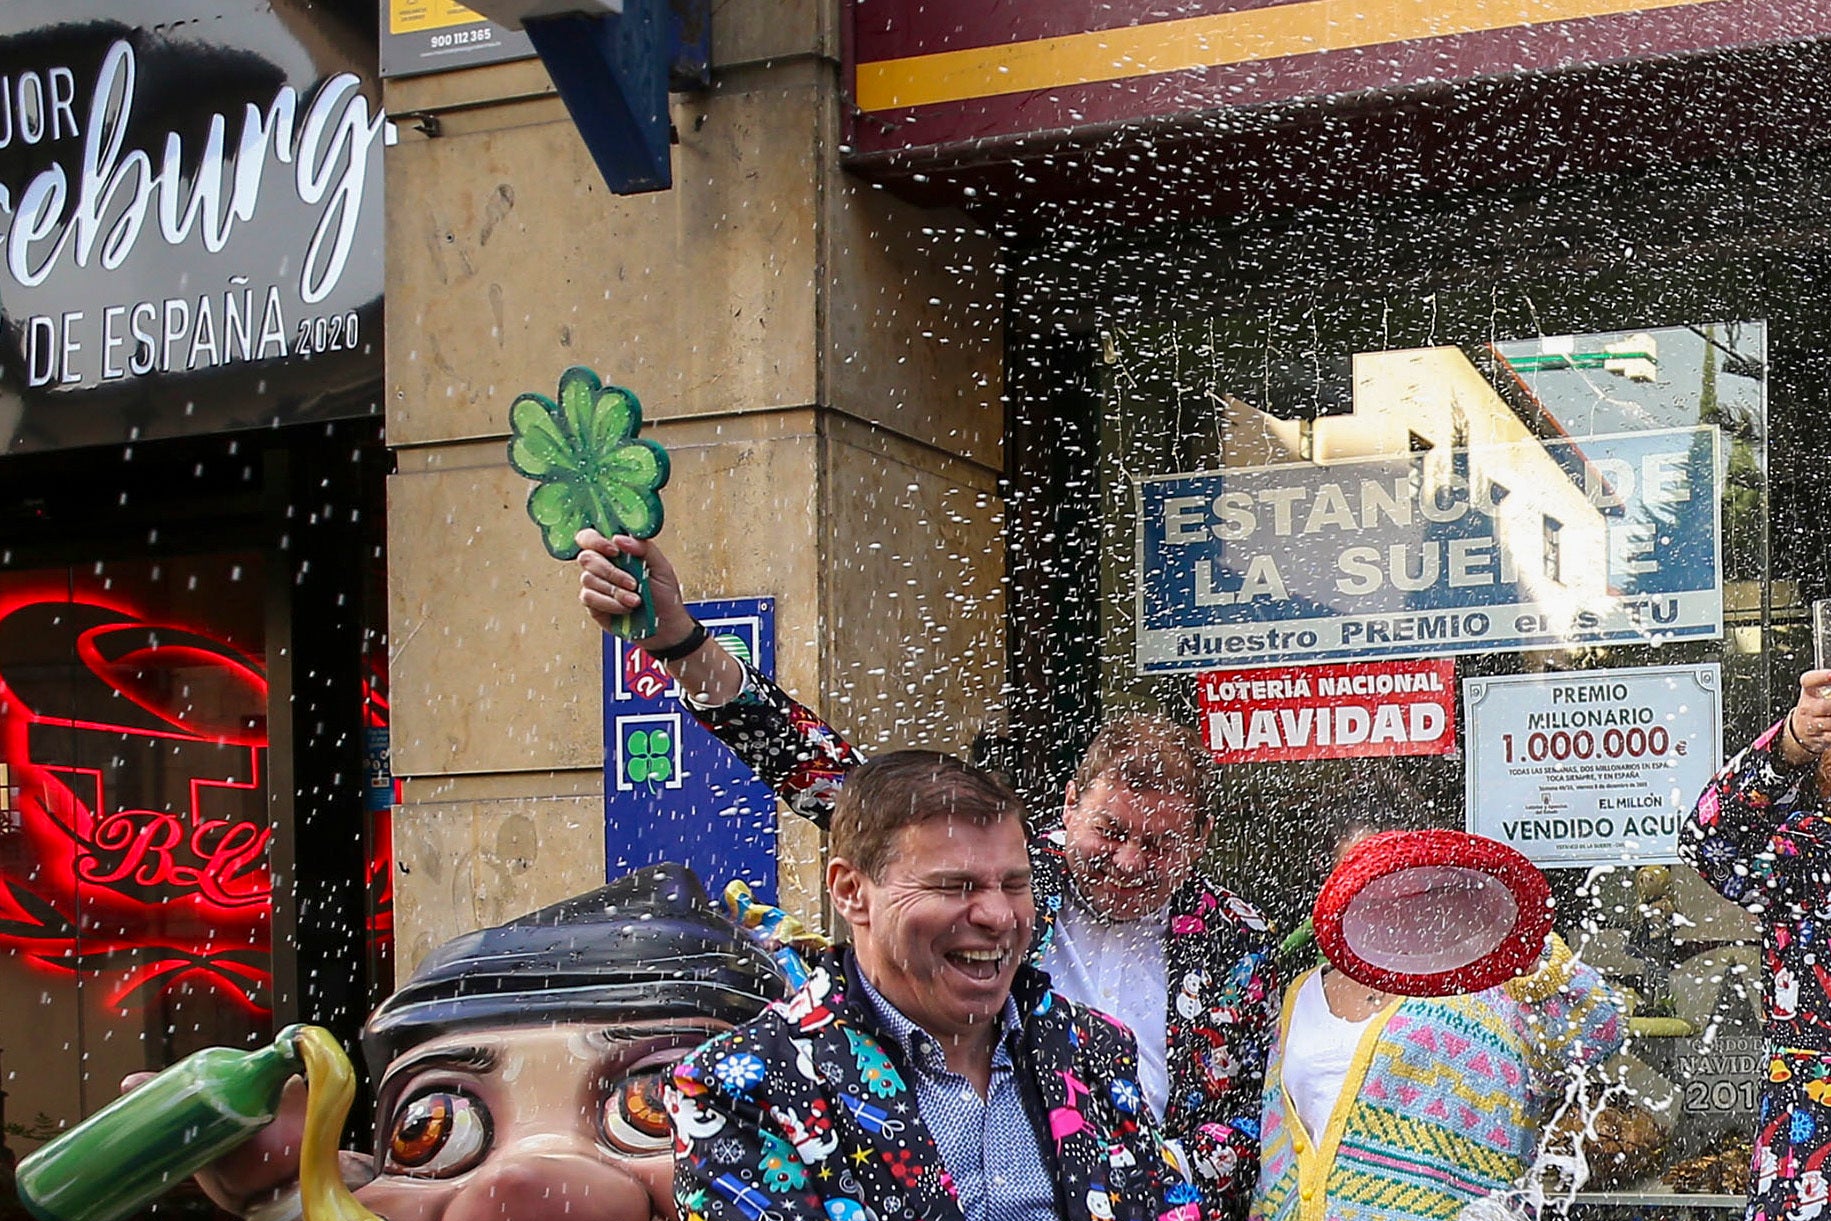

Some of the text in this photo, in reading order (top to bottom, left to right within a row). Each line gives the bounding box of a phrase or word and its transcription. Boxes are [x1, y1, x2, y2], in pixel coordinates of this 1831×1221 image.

[430, 28, 492, 48] 900 112 365
[0, 39, 388, 304] eburg
[29, 275, 359, 387] DE ESPAÑA 2020
[1586, 452, 1690, 505] DE
[1195, 522, 1657, 606] LA SUEE
[1176, 627, 1318, 658] Nuestro
[1341, 611, 1491, 645] PREMIO
[1623, 598, 1678, 624] TU
[1206, 672, 1443, 702] LOTERÍA NACIONAL
[1553, 684, 1628, 704] PREMIO
[1209, 702, 1446, 751] NAVIDAD
[1528, 707, 1654, 730] MILLONARIO
[1502, 726, 1669, 763] 1.000.000
[1599, 792, 1662, 809] EL MILLÓN
[1503, 811, 1681, 841] VENDIDO AQUÍ
[1685, 1081, 1758, 1110] 201
